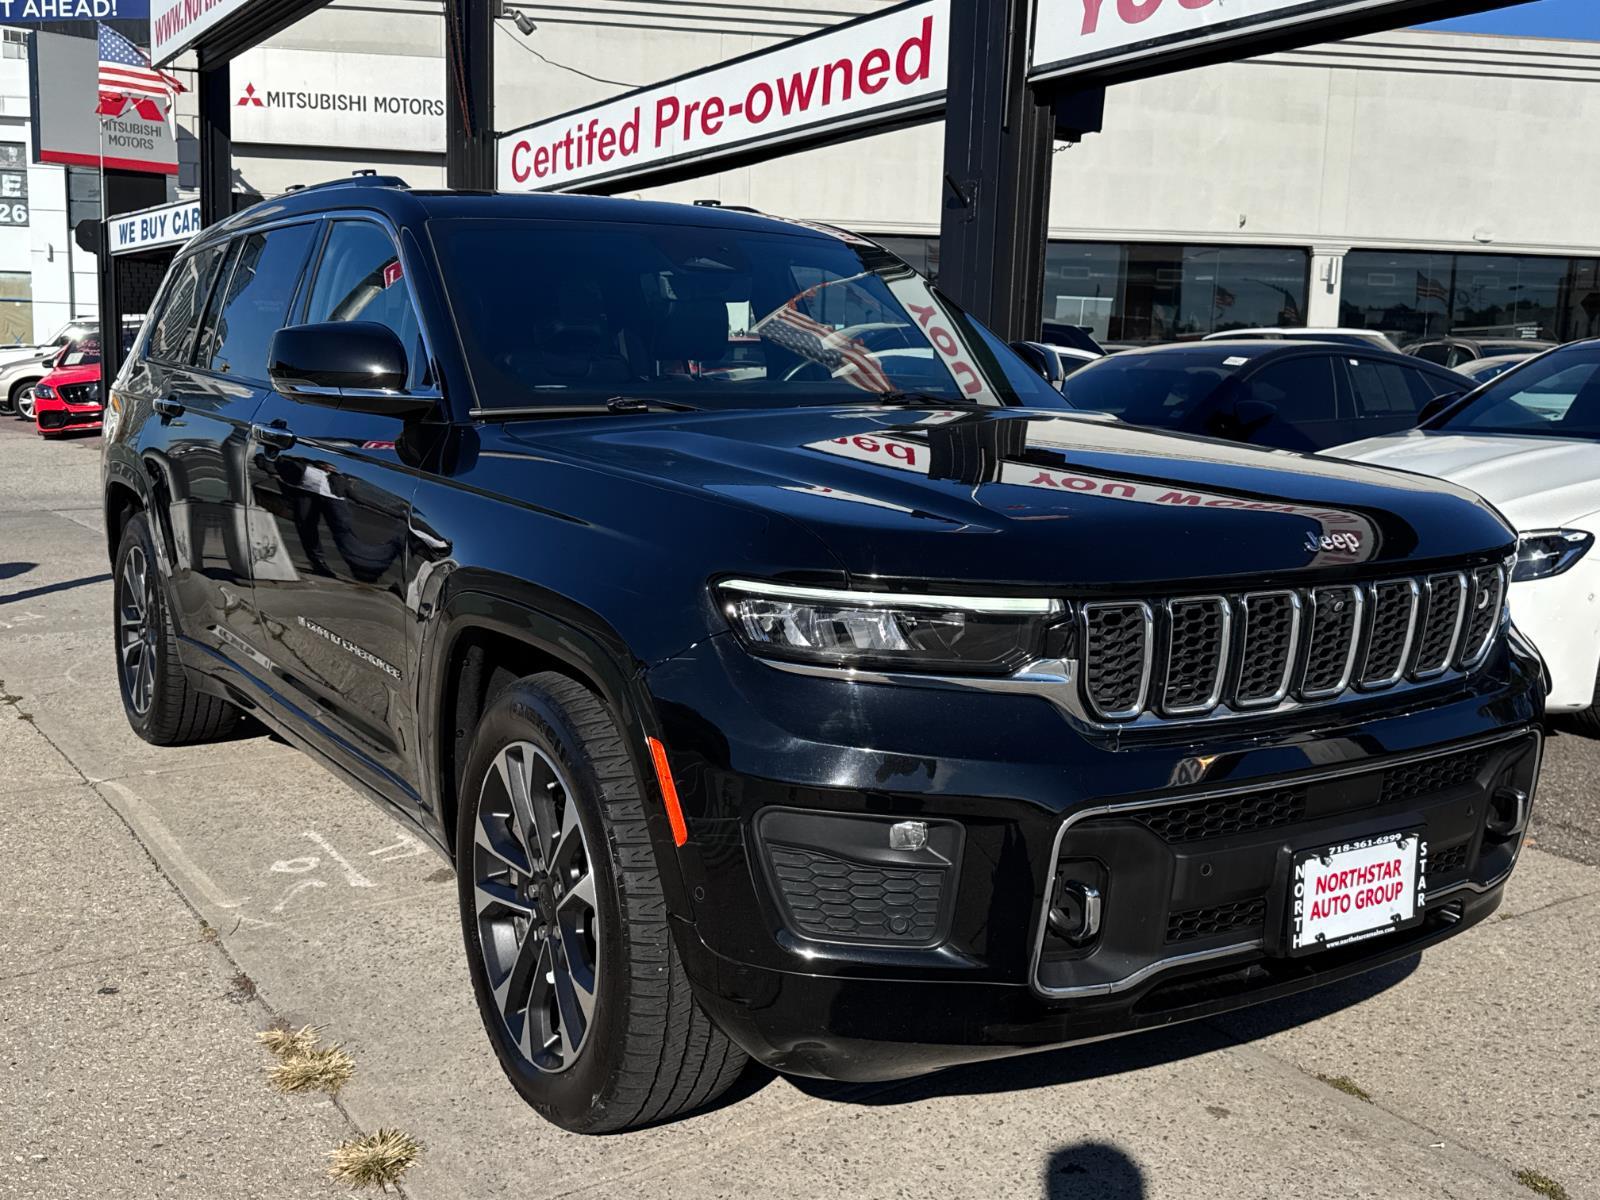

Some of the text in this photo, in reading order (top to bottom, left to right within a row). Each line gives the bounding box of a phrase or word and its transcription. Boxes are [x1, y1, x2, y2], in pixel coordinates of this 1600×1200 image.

[22, 0, 118, 17] AHEAD!
[267, 91, 444, 116] MITSUBISHI MOTORS
[511, 15, 933, 183] Certifed Pre-owned
[101, 120, 162, 137] MITSUBISHI
[108, 134, 154, 150] MOTORS
[119, 221, 136, 245] WE
[141, 214, 167, 240] BUY
[1304, 531, 1360, 552] Jeep
[1328, 833, 1402, 855] 718-361-6299
[1315, 859, 1402, 895] NORTHSTAR
[1417, 841, 1428, 907] STAR
[1293, 864, 1304, 949] NORTH
[1309, 882, 1404, 921] AUTO GROUP
